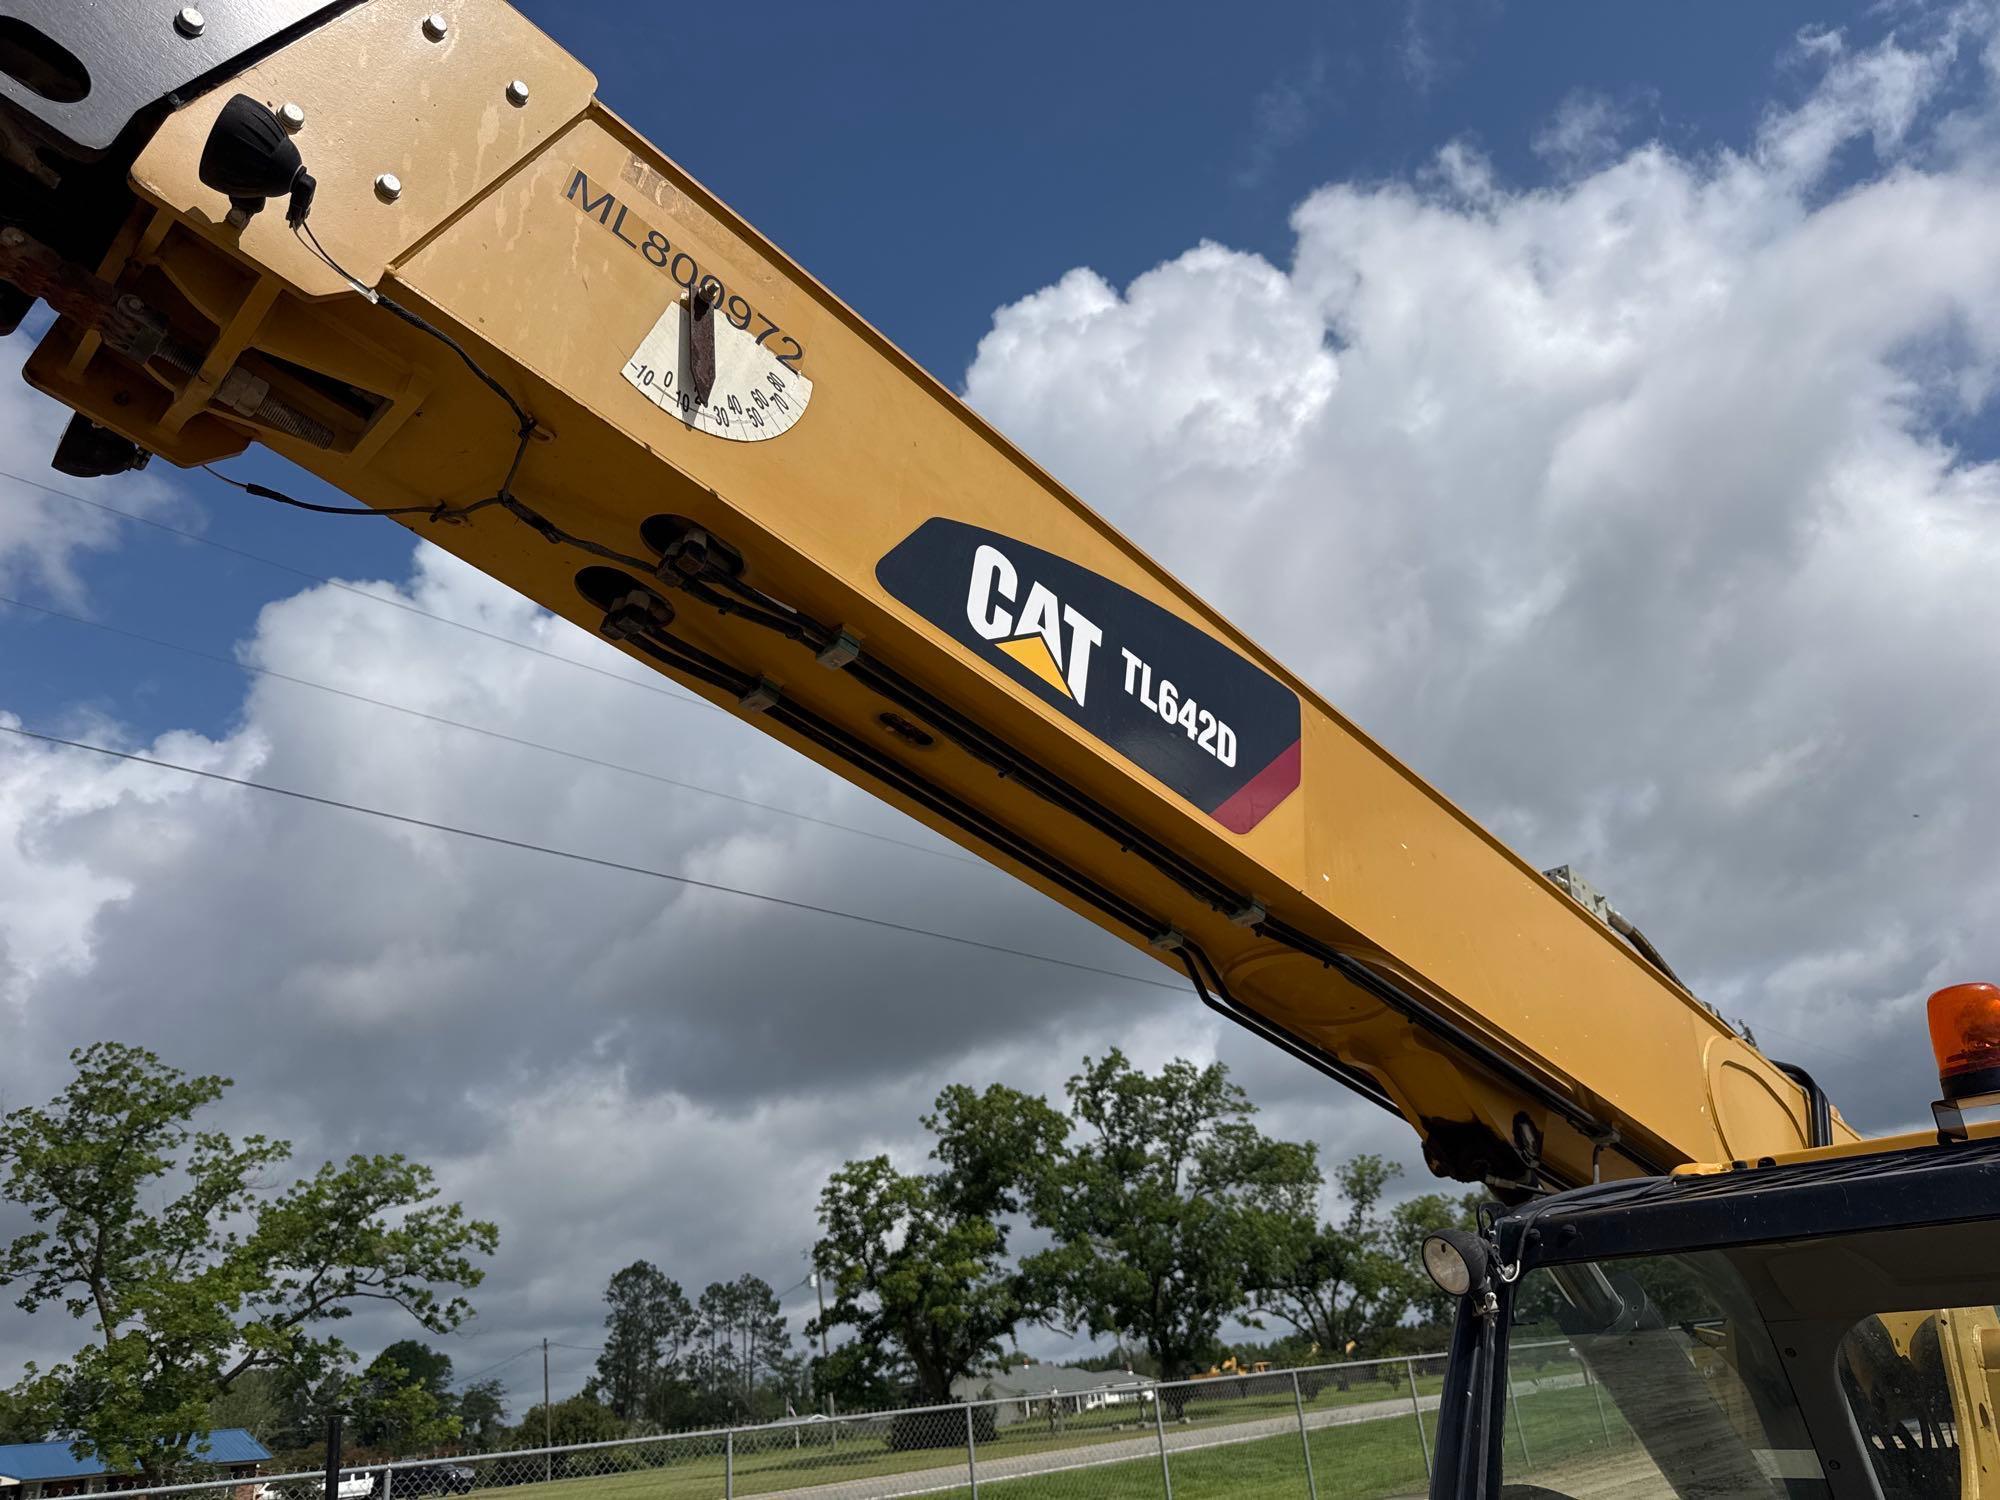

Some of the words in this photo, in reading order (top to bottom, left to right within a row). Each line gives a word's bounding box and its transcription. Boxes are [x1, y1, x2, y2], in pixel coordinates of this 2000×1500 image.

[630, 362, 655, 386] -10
[663, 370, 674, 388] 0
[766, 371, 786, 393] 80
[676, 389, 690, 413] 10
[727, 394, 743, 416] 40
[750, 388, 770, 410] 60
[769, 392, 790, 415] 70
[713, 405, 730, 428] 30
[745, 406, 765, 428] 50
[966, 544, 1103, 708] CAT
[1121, 646, 1238, 769] TL642D
